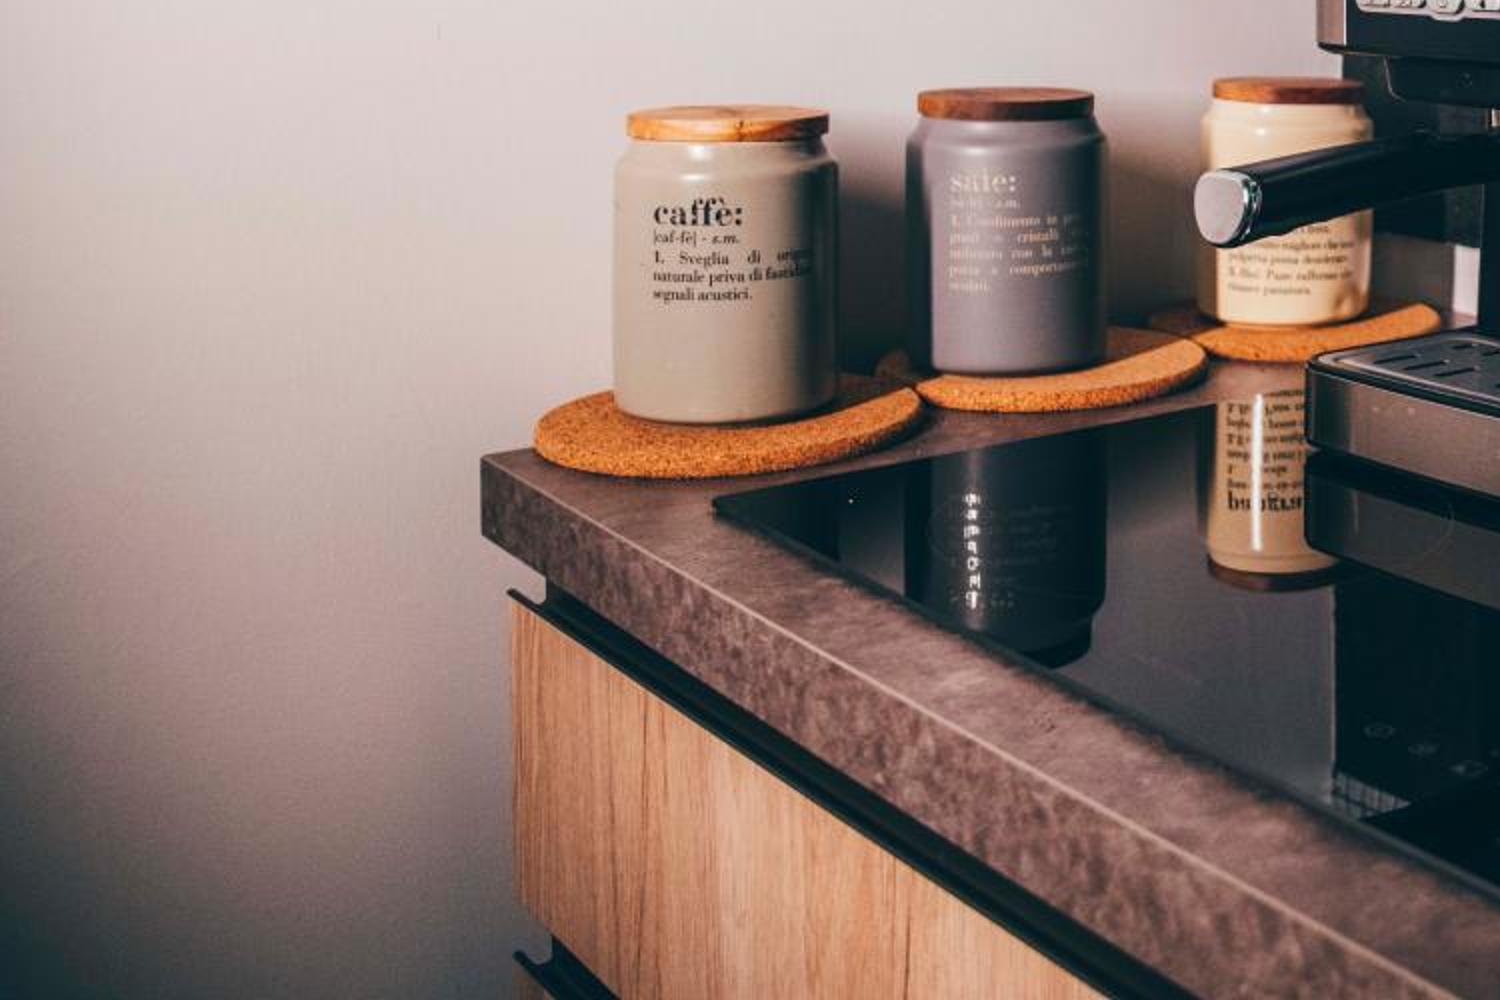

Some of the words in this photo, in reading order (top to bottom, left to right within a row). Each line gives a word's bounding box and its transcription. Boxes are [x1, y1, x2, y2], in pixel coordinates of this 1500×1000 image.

[653, 197, 742, 227] caffè:
[678, 251, 729, 269] Sveglia
[746, 249, 762, 263] di
[653, 269, 705, 283] naturale
[708, 270, 745, 287] priva
[653, 287, 695, 304] segnali
